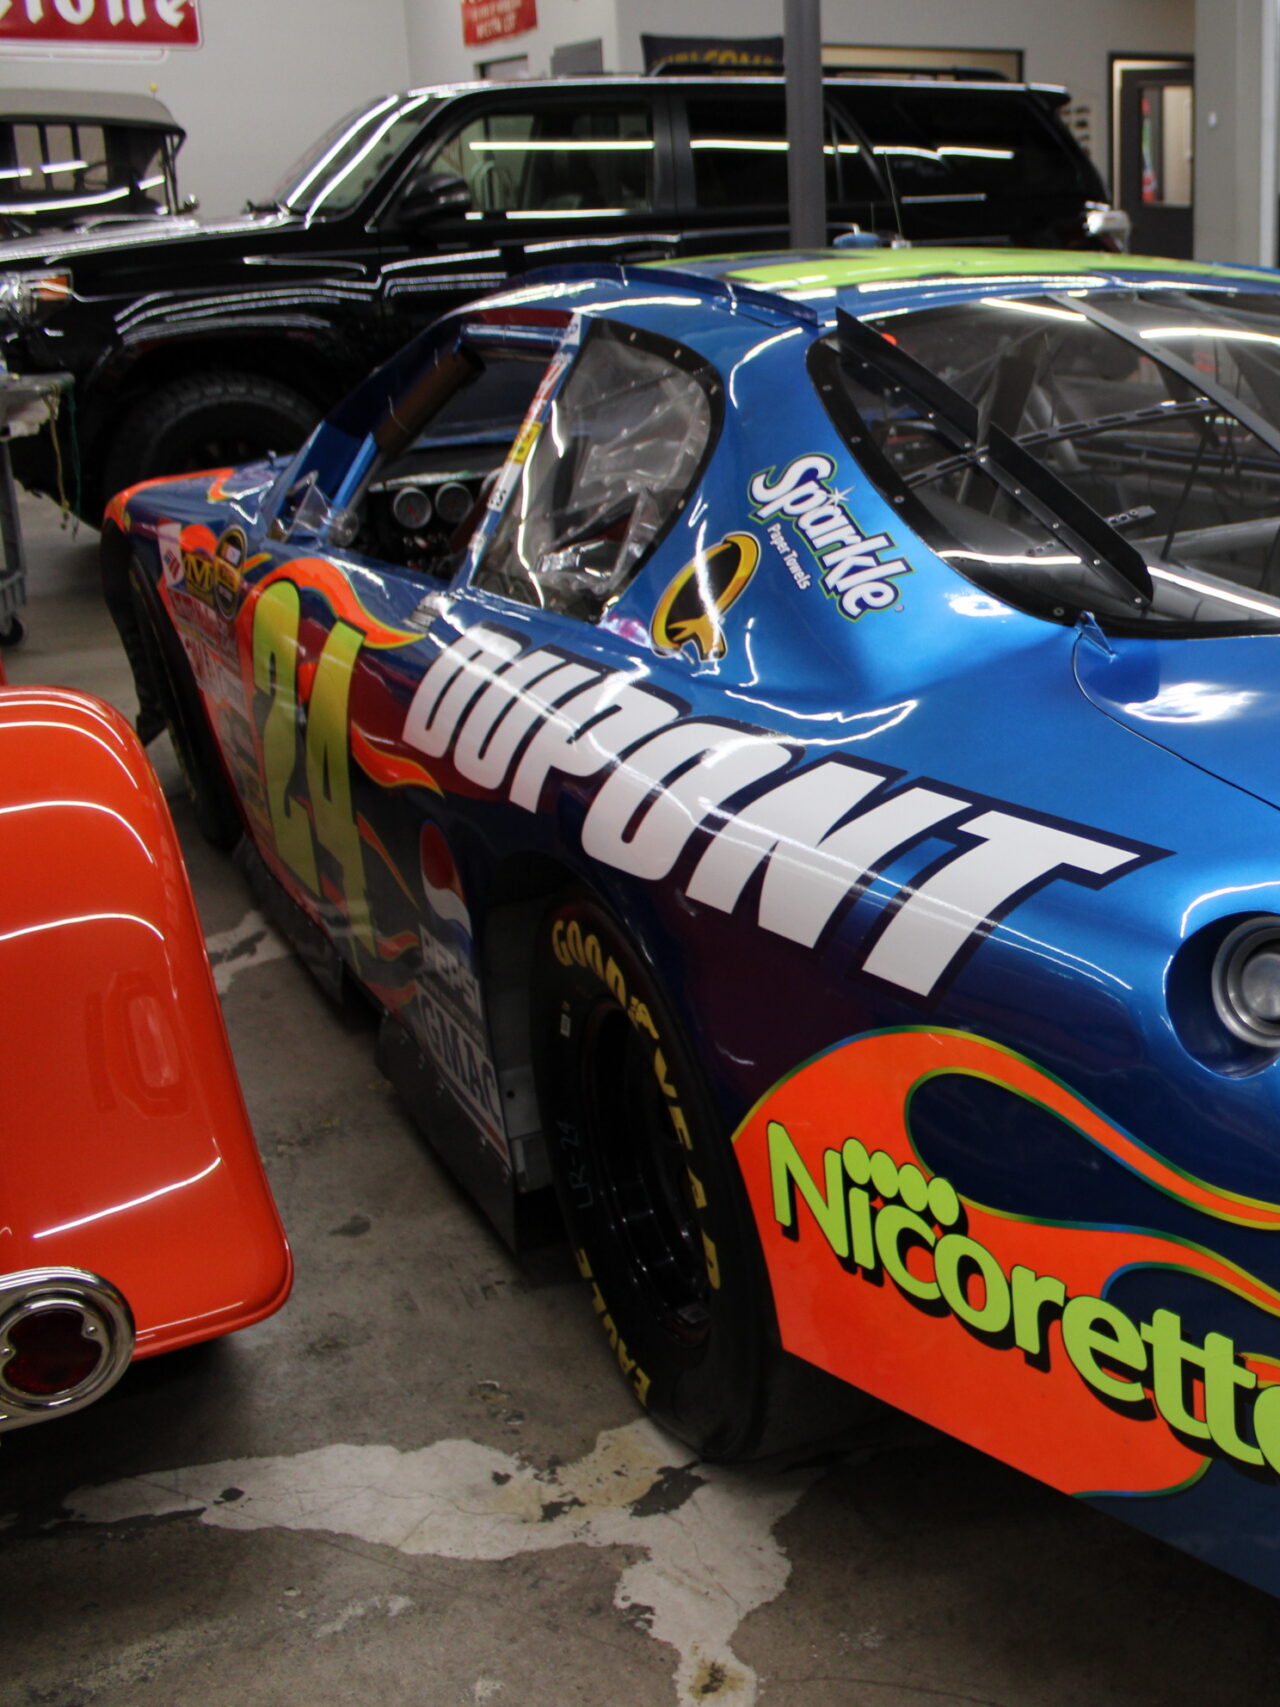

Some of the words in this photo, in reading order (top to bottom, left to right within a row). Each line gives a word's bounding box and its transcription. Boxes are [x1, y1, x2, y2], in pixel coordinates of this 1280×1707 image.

[0, 0, 186, 28] tone
[650, 531, 761, 662] Q
[749, 453, 913, 620] Sparkle
[767, 522, 789, 555] Paper
[784, 549, 812, 590] Towels
[252, 578, 377, 960] 24
[402, 621, 1155, 998] DUPONT
